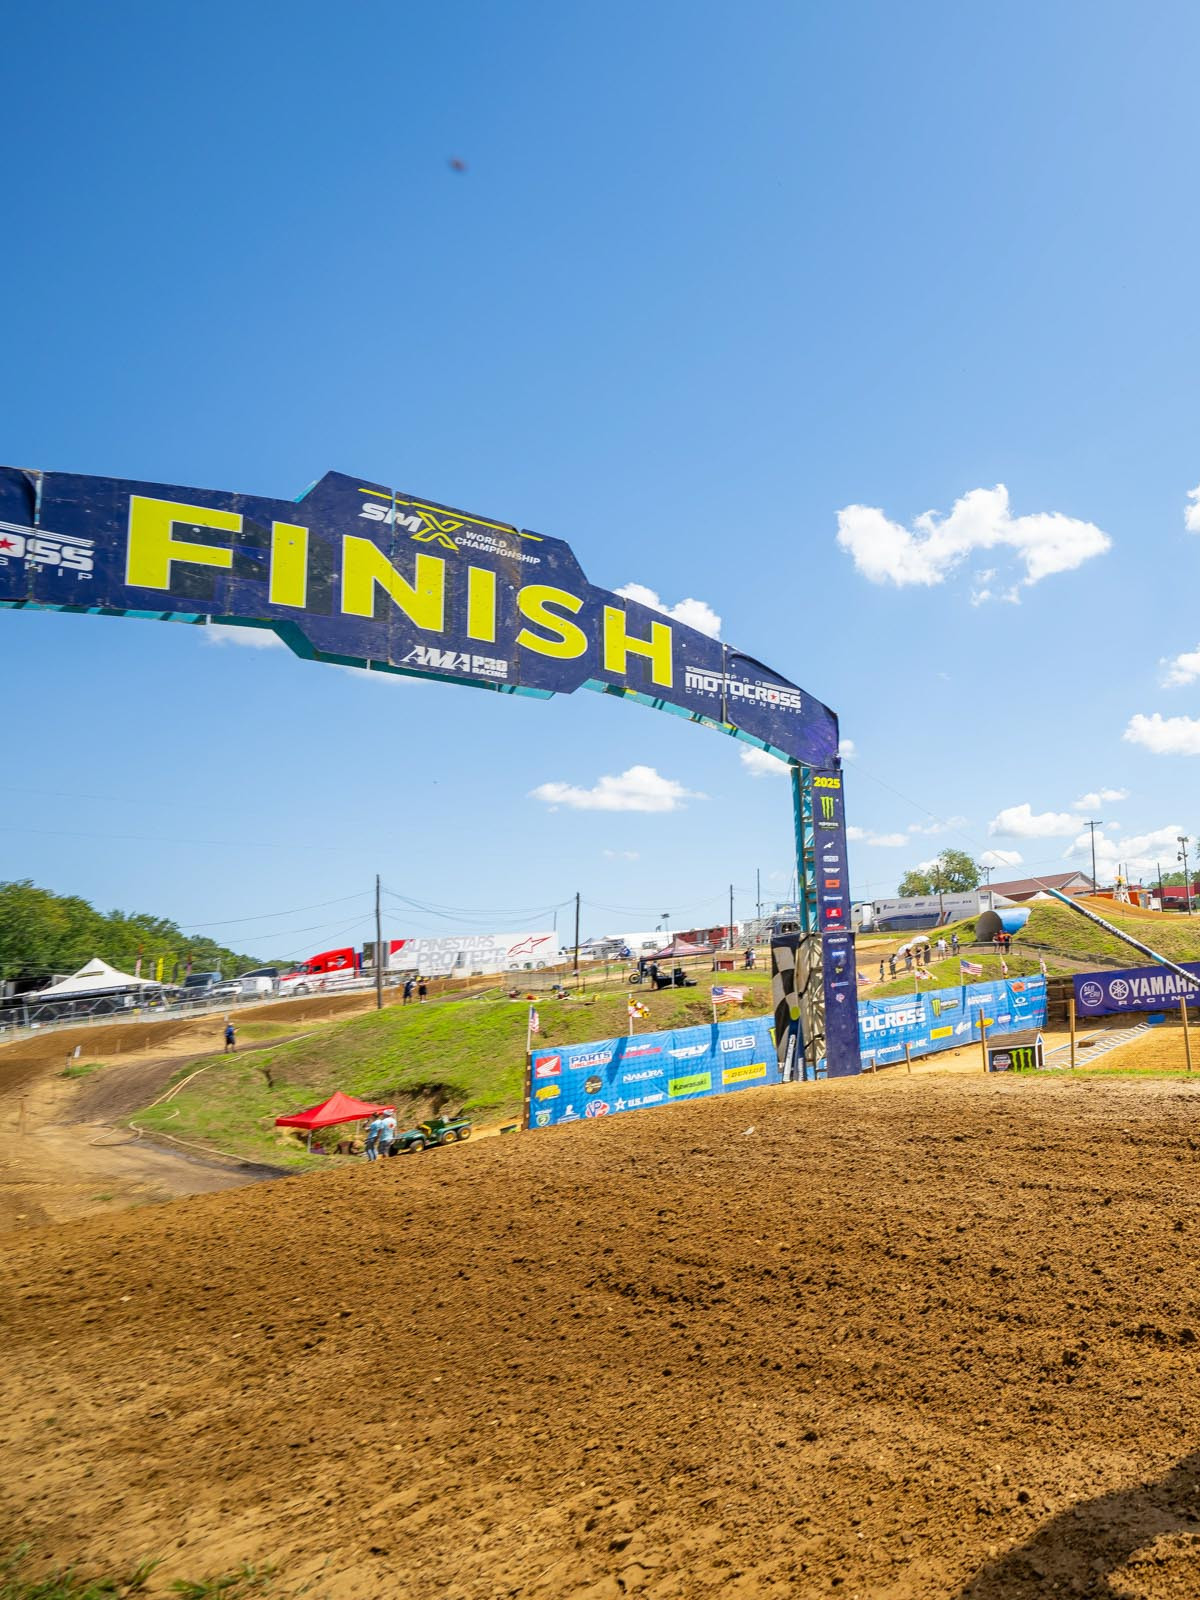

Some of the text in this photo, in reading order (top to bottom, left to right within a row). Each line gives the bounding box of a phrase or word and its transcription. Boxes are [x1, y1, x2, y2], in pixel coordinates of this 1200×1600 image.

[358, 502, 465, 551] SMX
[466, 531, 507, 548] WORLD
[454, 537, 541, 565] CHAMPIONSHIP
[125, 494, 674, 689] FINISH
[400, 645, 470, 672] AMA
[472, 655, 508, 672] PRO
[472, 667, 508, 679] RACING
[731, 674, 762, 687] PRO
[685, 672, 801, 709] MOTOCROSS
[685, 688, 801, 714] CHAMPIONSHIP
[813, 776, 841, 789] 2025
[1129, 972, 1200, 998] YAMAHA
[1118, 993, 1195, 1006] RACING
[722, 1036, 755, 1051] WPS
[570, 1051, 610, 1064] PARTS
[623, 1069, 664, 1083] NAMURA
[731, 1066, 765, 1078] DUNLOP
[673, 1079, 707, 1091] Kawasaki
